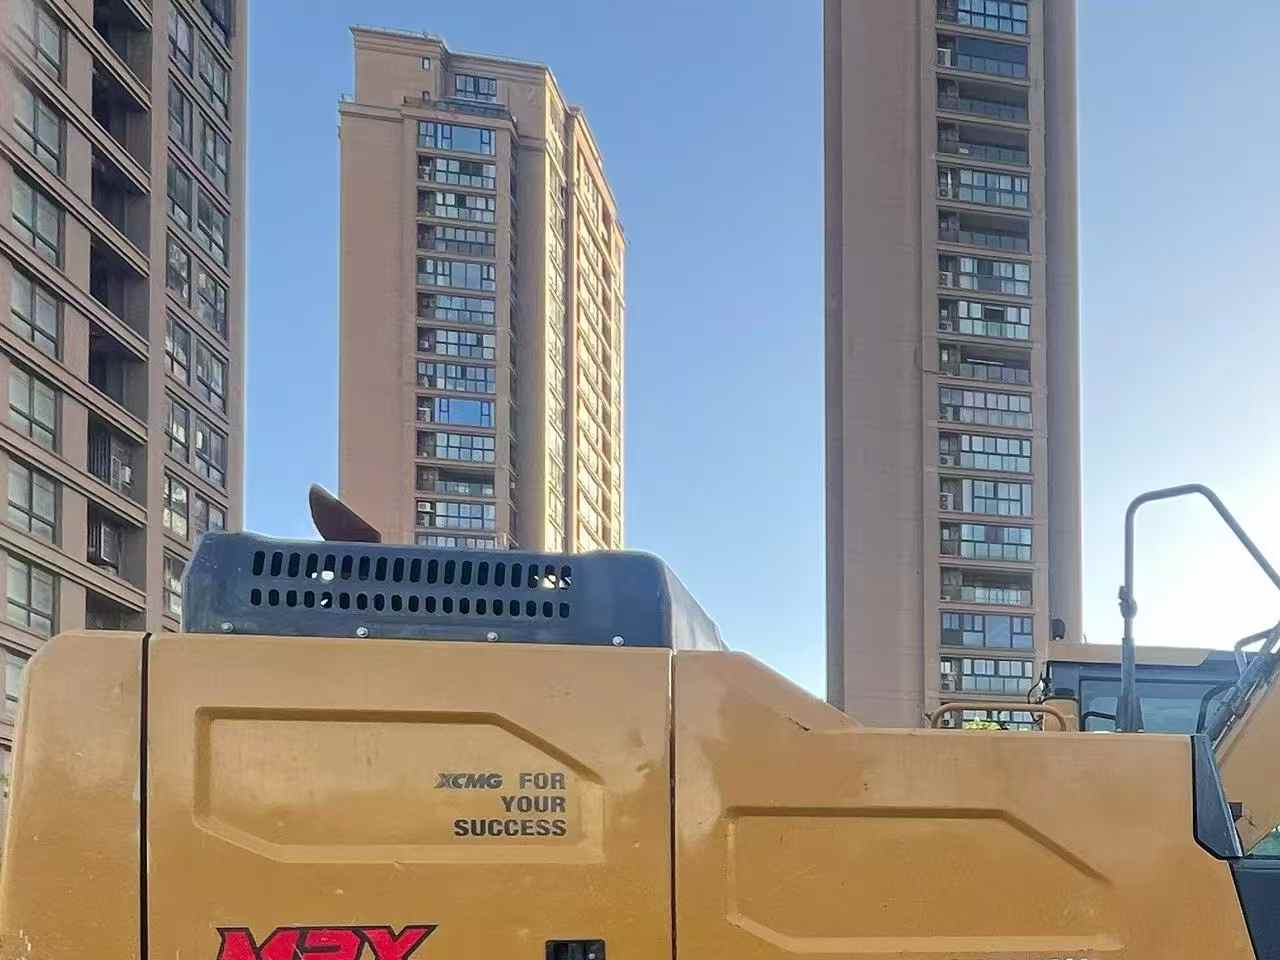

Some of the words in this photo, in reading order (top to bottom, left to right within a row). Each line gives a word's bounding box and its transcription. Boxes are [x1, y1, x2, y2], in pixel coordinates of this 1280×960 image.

[433, 773, 503, 789] XCMG
[519, 772, 566, 789] FOR
[500, 795, 566, 812] YOUR
[453, 819, 567, 836] SUCCESS
